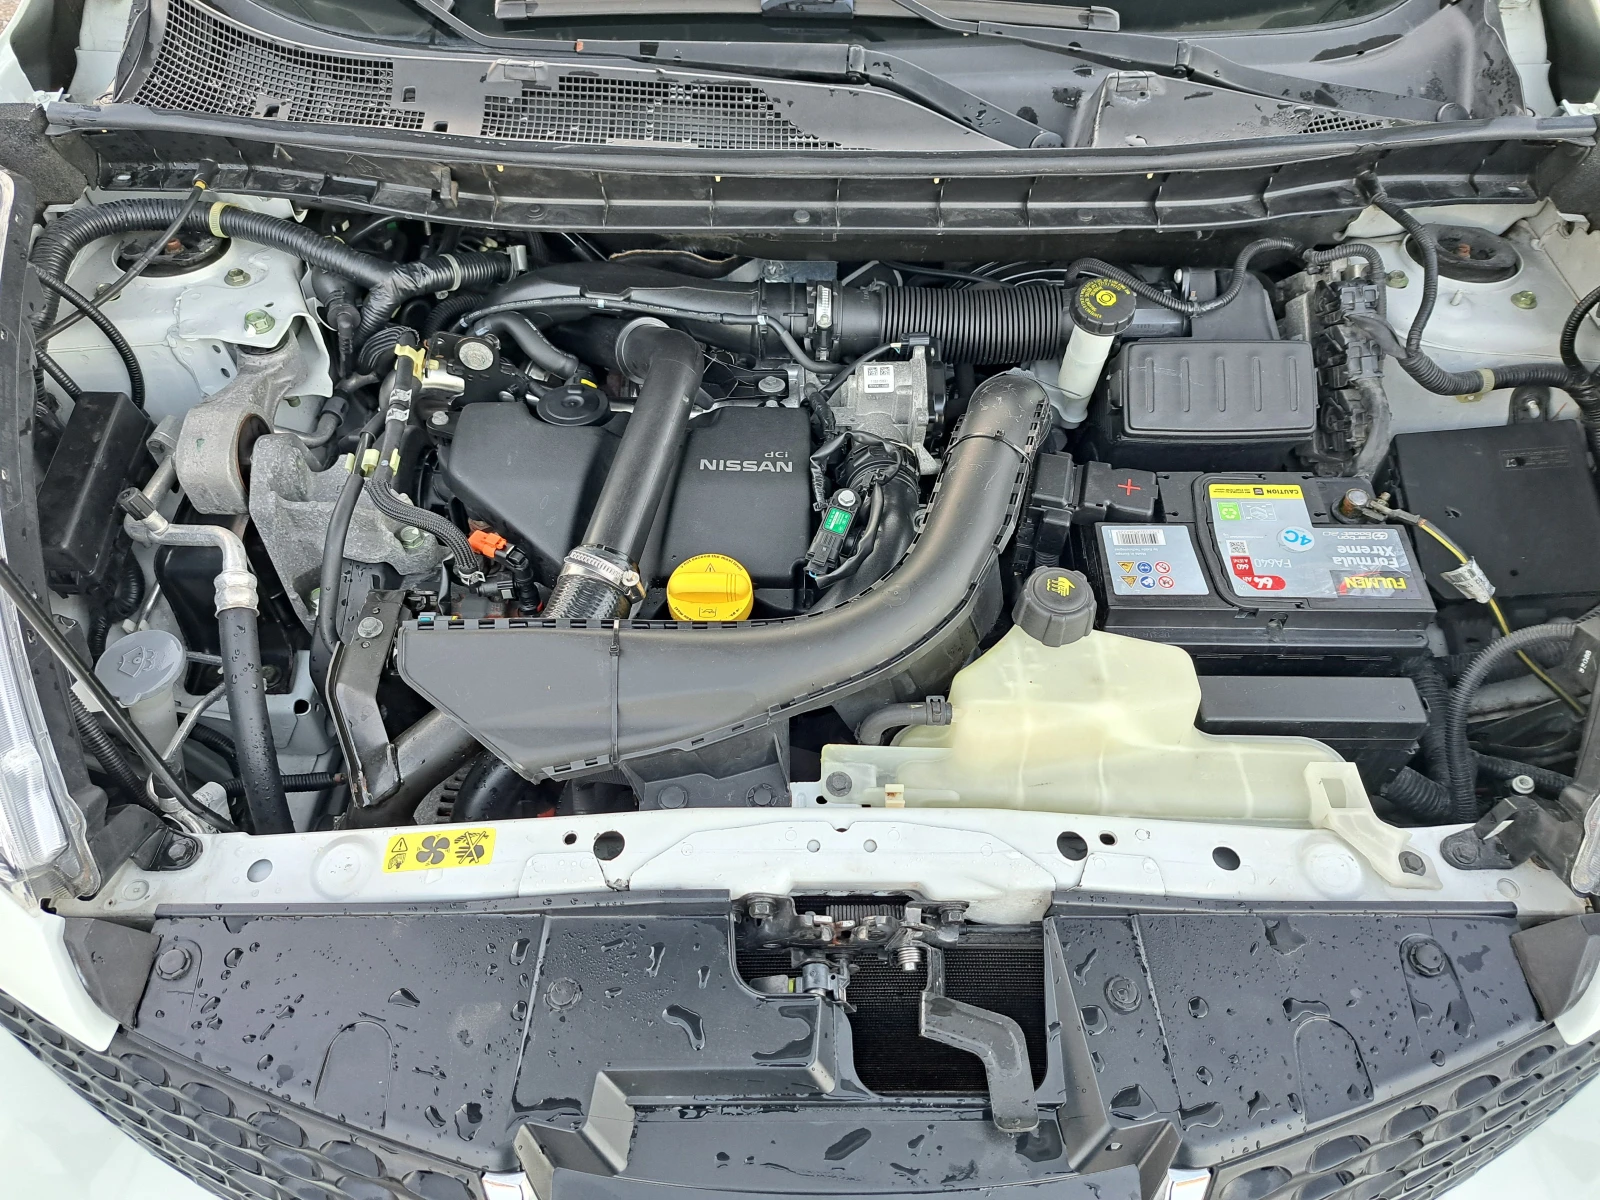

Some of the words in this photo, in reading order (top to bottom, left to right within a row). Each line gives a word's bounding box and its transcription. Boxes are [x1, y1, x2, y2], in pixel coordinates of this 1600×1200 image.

[699, 458, 793, 473] NISSAN
[1284, 529, 1312, 547] 4C
[1336, 545, 1394, 556] Xtreme
[1254, 558, 1292, 568] FA640
[1332, 556, 1398, 568] Formula
[1254, 576, 1273, 588] 64
[1344, 576, 1407, 590] FULMEN
